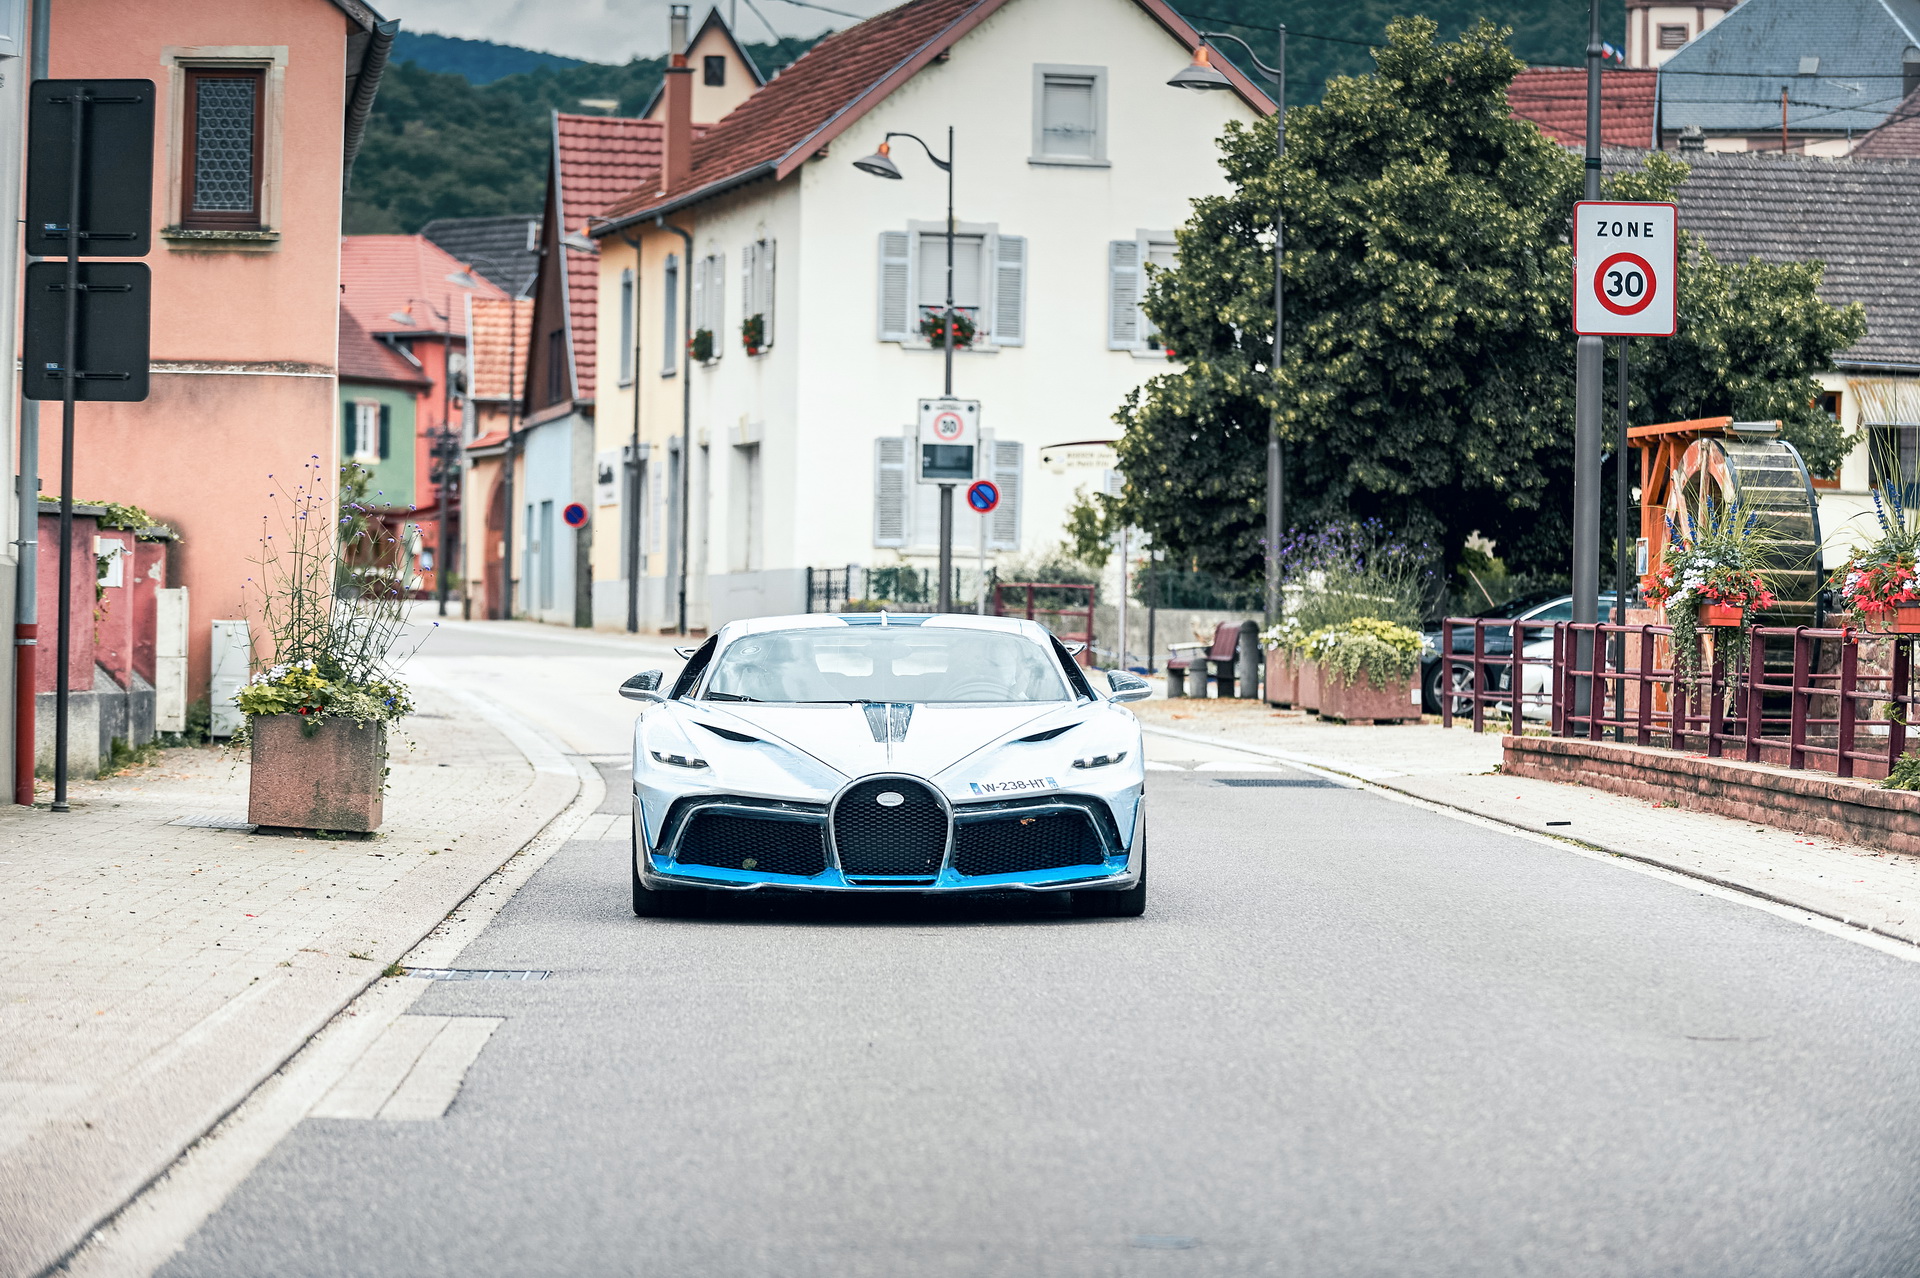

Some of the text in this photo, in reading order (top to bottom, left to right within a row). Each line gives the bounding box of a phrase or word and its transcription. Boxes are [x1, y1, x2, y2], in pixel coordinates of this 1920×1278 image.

[1597, 221, 1654, 238] ZONE
[1606, 271, 1644, 298] 30
[941, 420, 957, 433] 30
[981, 778, 1046, 793] W-238-HT
